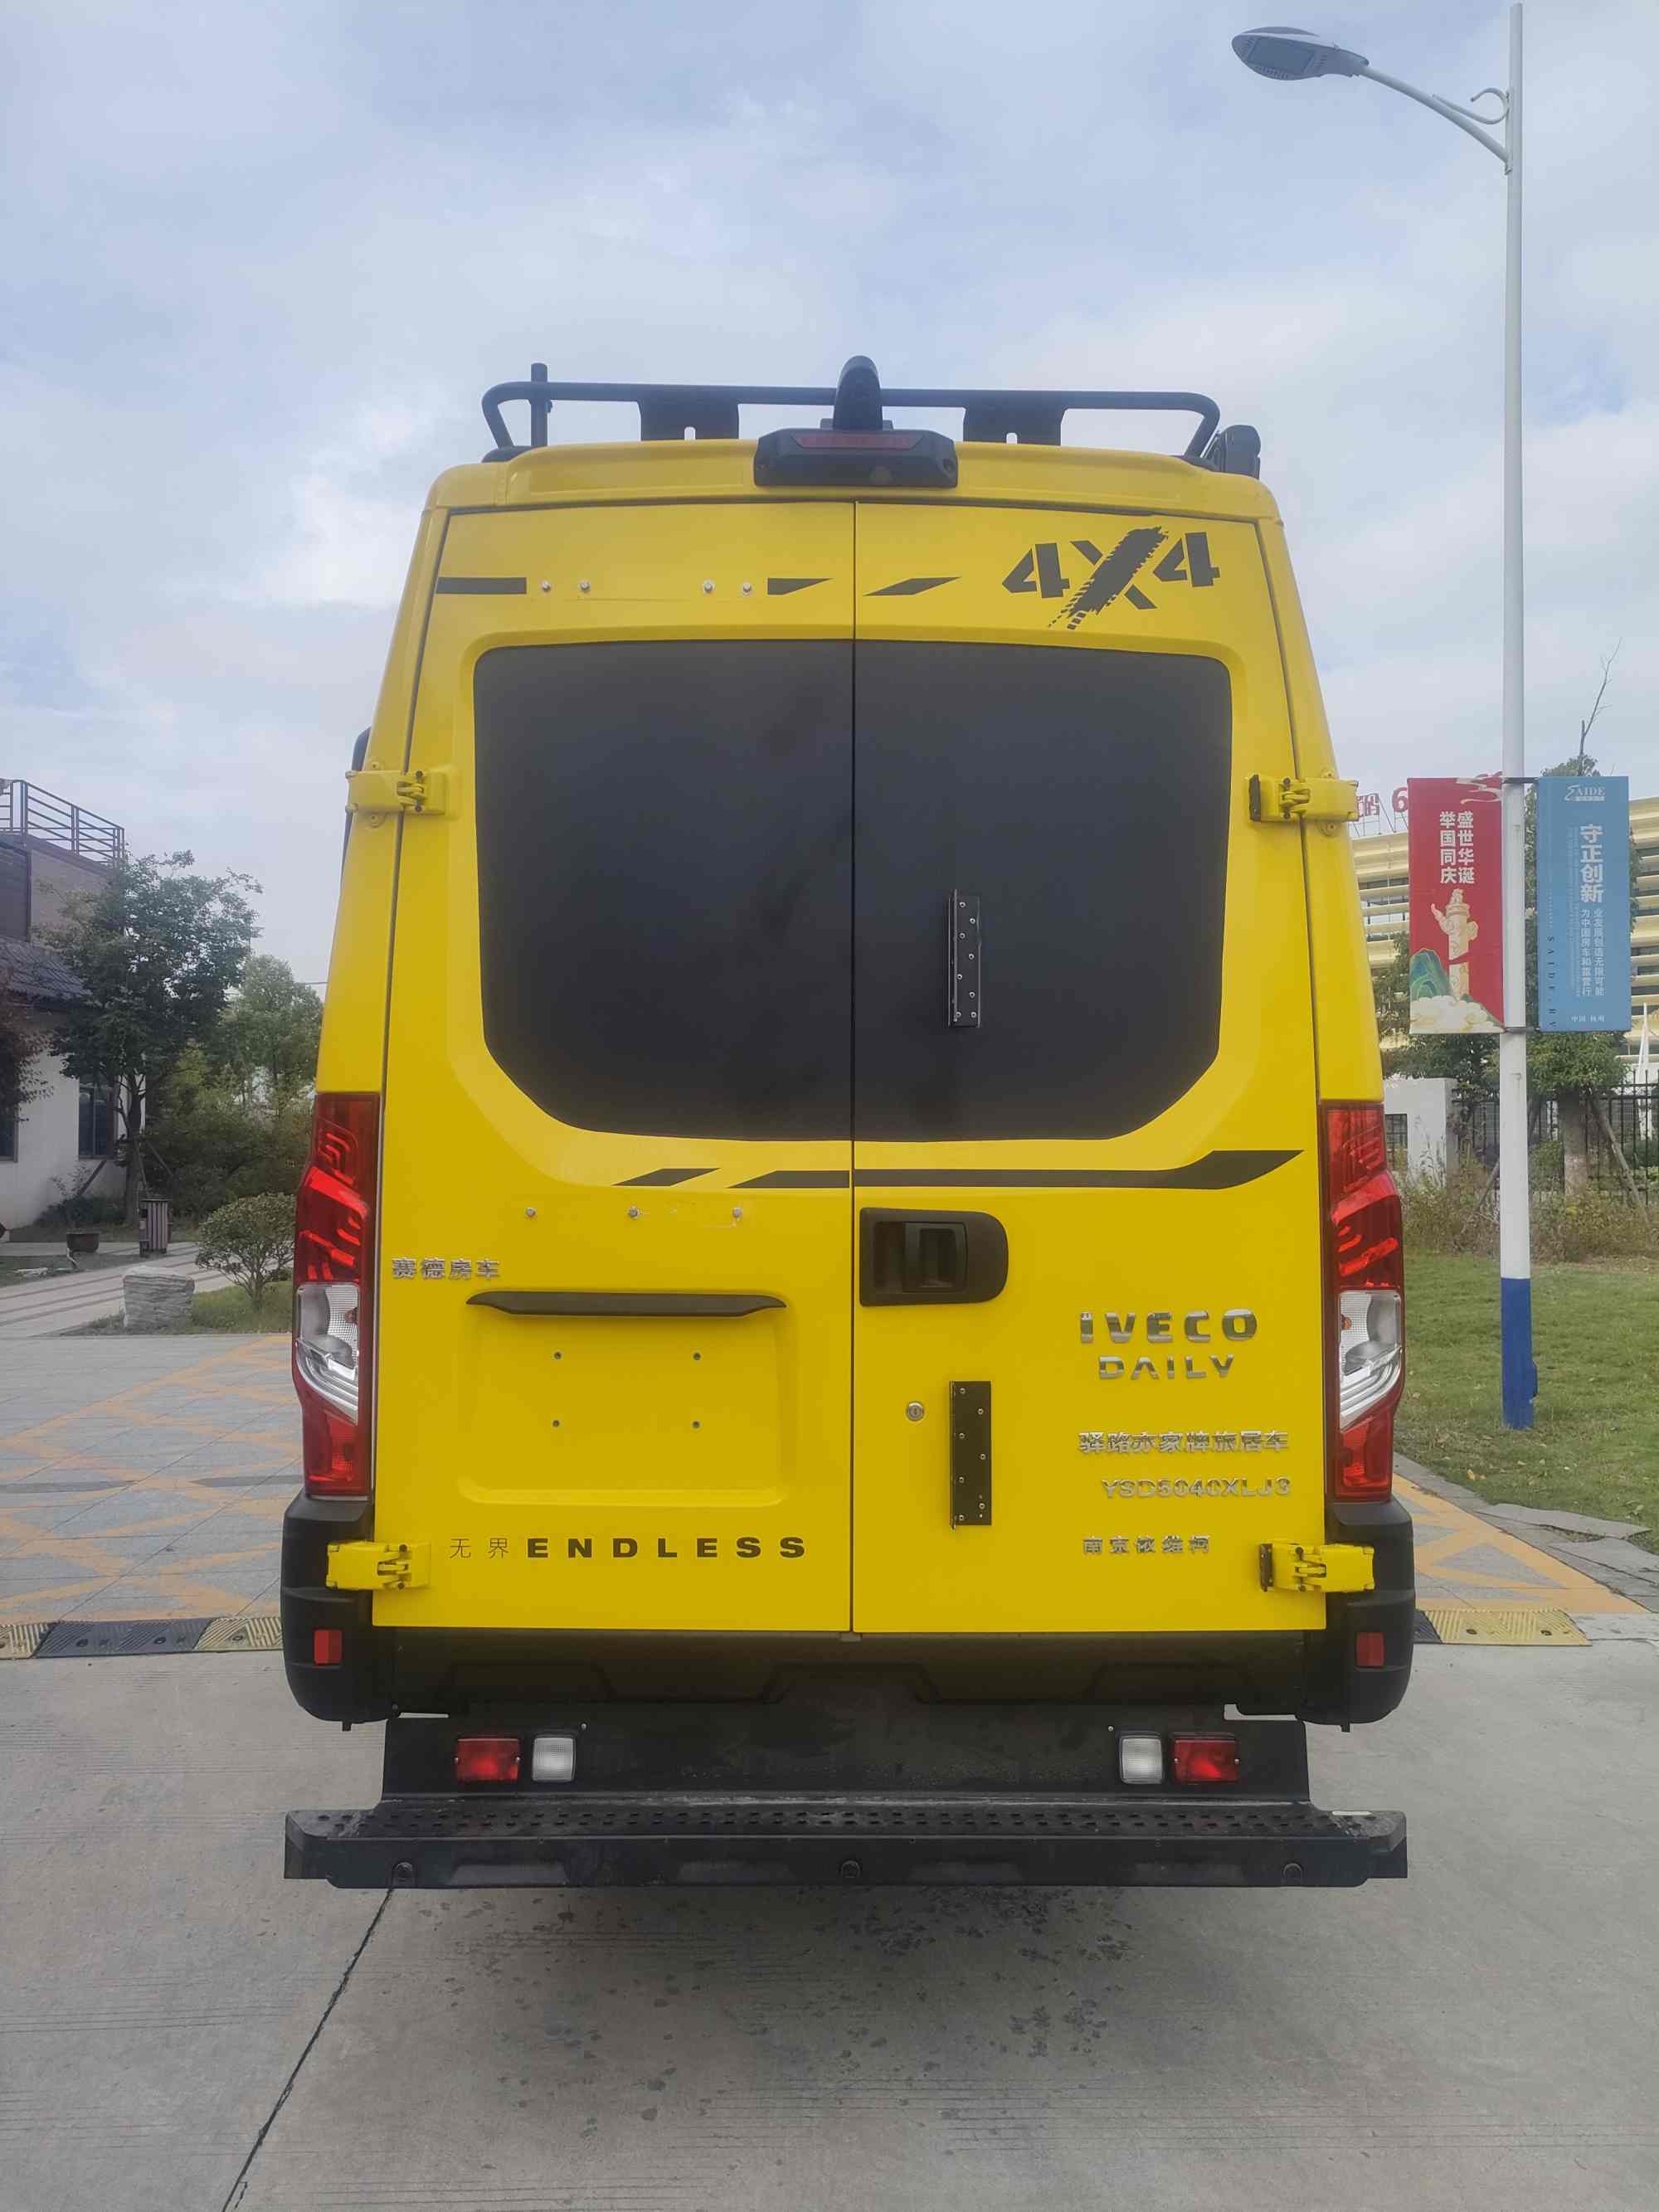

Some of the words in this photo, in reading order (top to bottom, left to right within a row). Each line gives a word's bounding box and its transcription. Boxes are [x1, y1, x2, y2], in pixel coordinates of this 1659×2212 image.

[1440, 811, 1457, 884] 举国同庆
[1457, 810, 1475, 884] 盛世华诞
[1579, 823, 1604, 903] 守正创新
[392, 1257, 500, 1280] 赛德房车
[1080, 1309, 1258, 1344] IVECO
[1099, 1354, 1234, 1380] DAILY
[449, 1538, 508, 1559] 无界
[527, 1537, 805, 1559] ENDLESS
[1082, 1535, 1210, 1554] 南京依维柯
